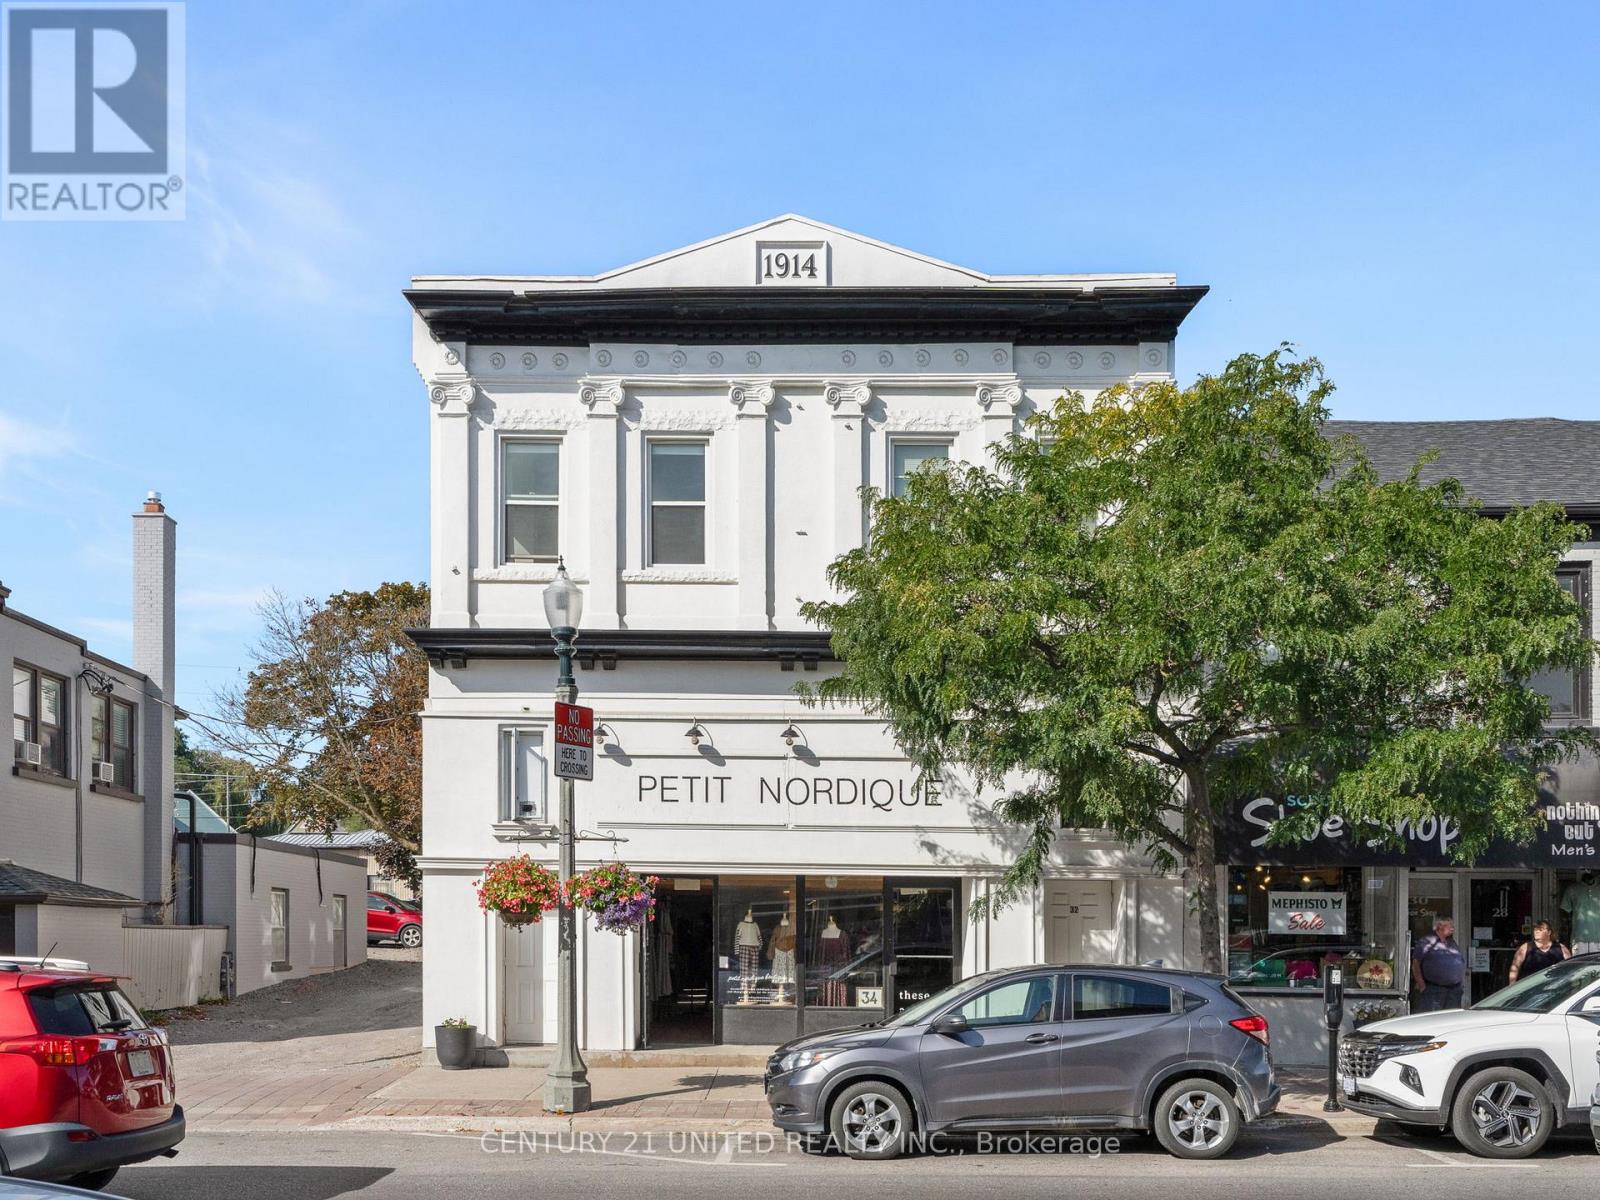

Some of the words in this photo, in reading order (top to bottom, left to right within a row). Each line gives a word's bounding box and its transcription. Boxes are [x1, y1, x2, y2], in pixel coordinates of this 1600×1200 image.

[764, 252, 818, 279] 1914
[568, 708, 580, 725] NO
[557, 724, 591, 744] PASSING
[561, 747, 577, 760] HERE
[579, 749, 587, 761] TO
[560, 761, 588, 775] CROSSING
[638, 775, 732, 803] PETIT
[759, 776, 943, 812] NORDIQUE
[1551, 843, 1595, 856] Men's
[1271, 898, 1328, 909] MEPHISTO
[1287, 913, 1326, 930] Sale
[862, 991, 878, 1005] 34
[899, 989, 930, 1000] these
